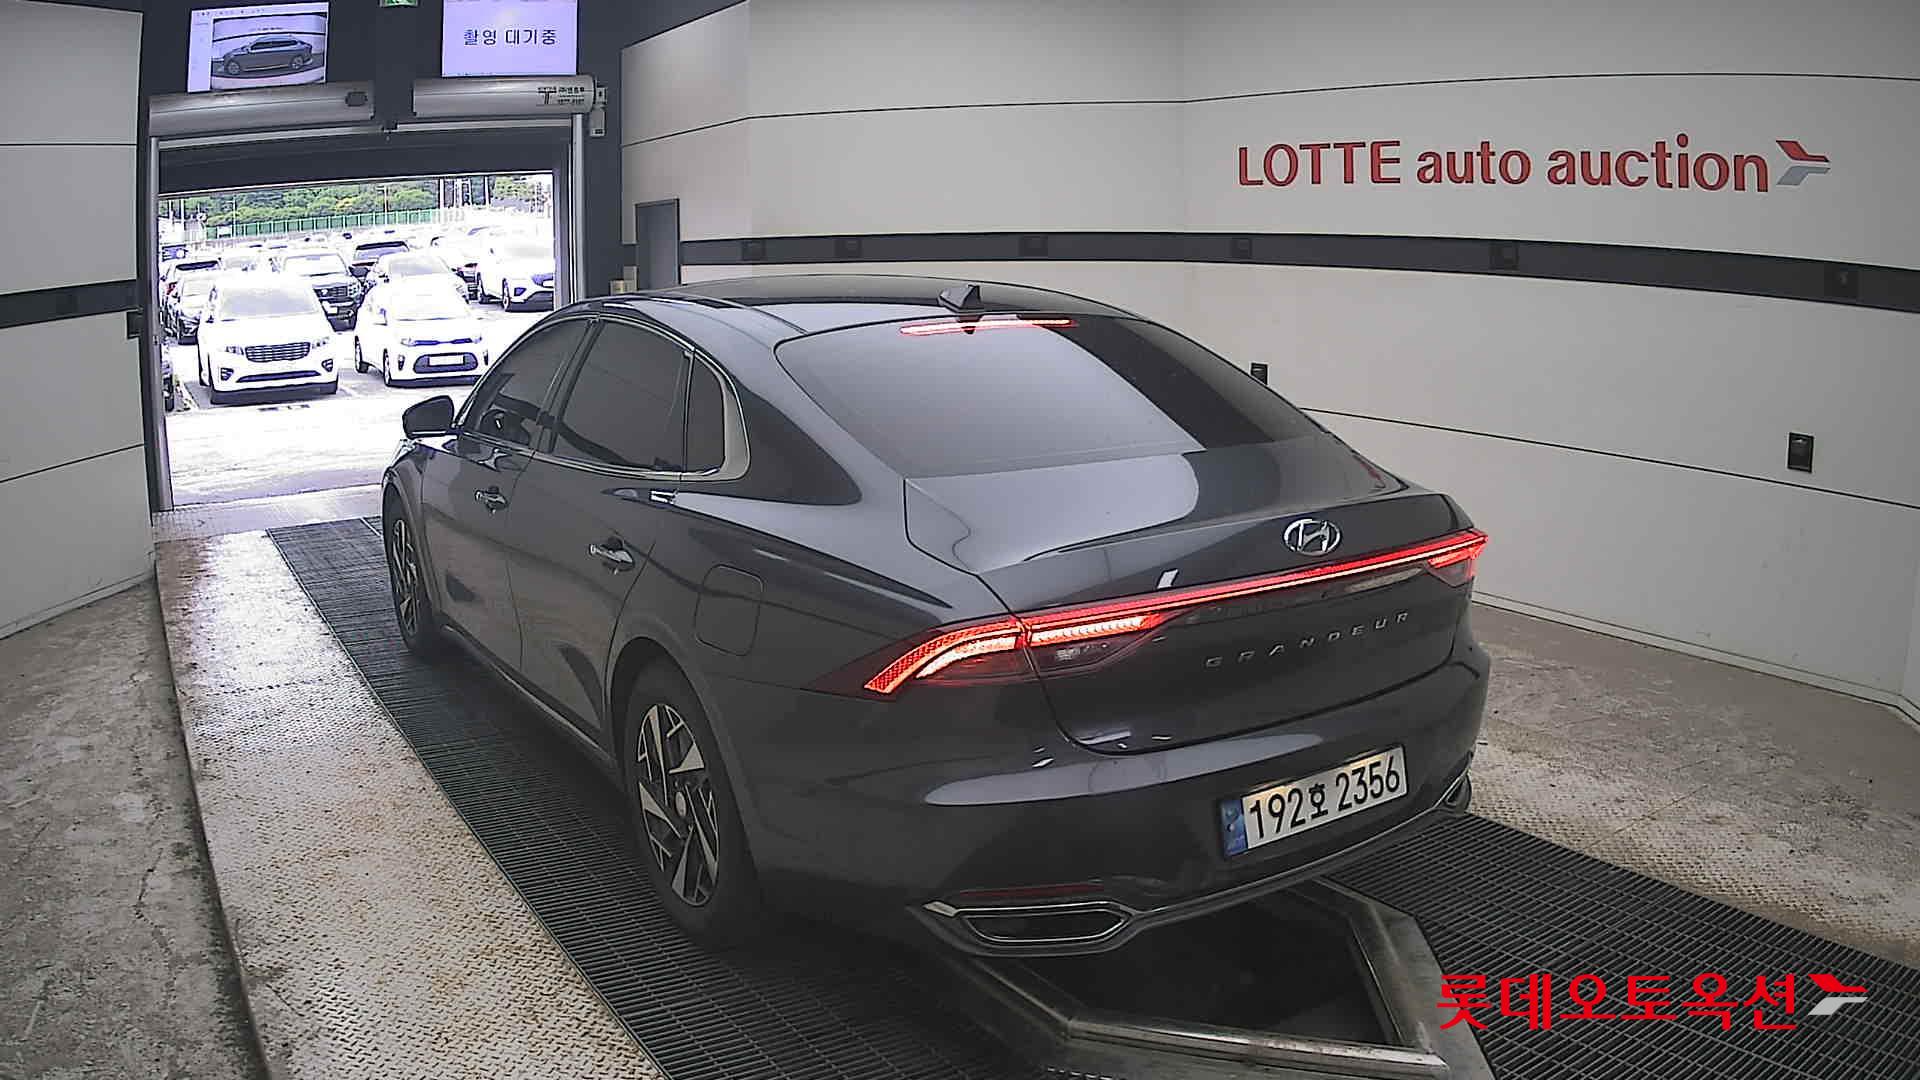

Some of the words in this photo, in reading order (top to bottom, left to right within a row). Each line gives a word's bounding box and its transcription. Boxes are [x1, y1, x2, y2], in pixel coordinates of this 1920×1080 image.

[464, 29, 497, 46] 촬영
[505, 29, 557, 45] 대기중
[1237, 140, 1401, 187] LOTTE
[1416, 140, 1532, 185] auto
[1547, 133, 1769, 193] auction
[1205, 611, 1409, 668] GRANDEUR
[1250, 783, 1328, 839] 192호
[1336, 756, 1400, 812] 2356
